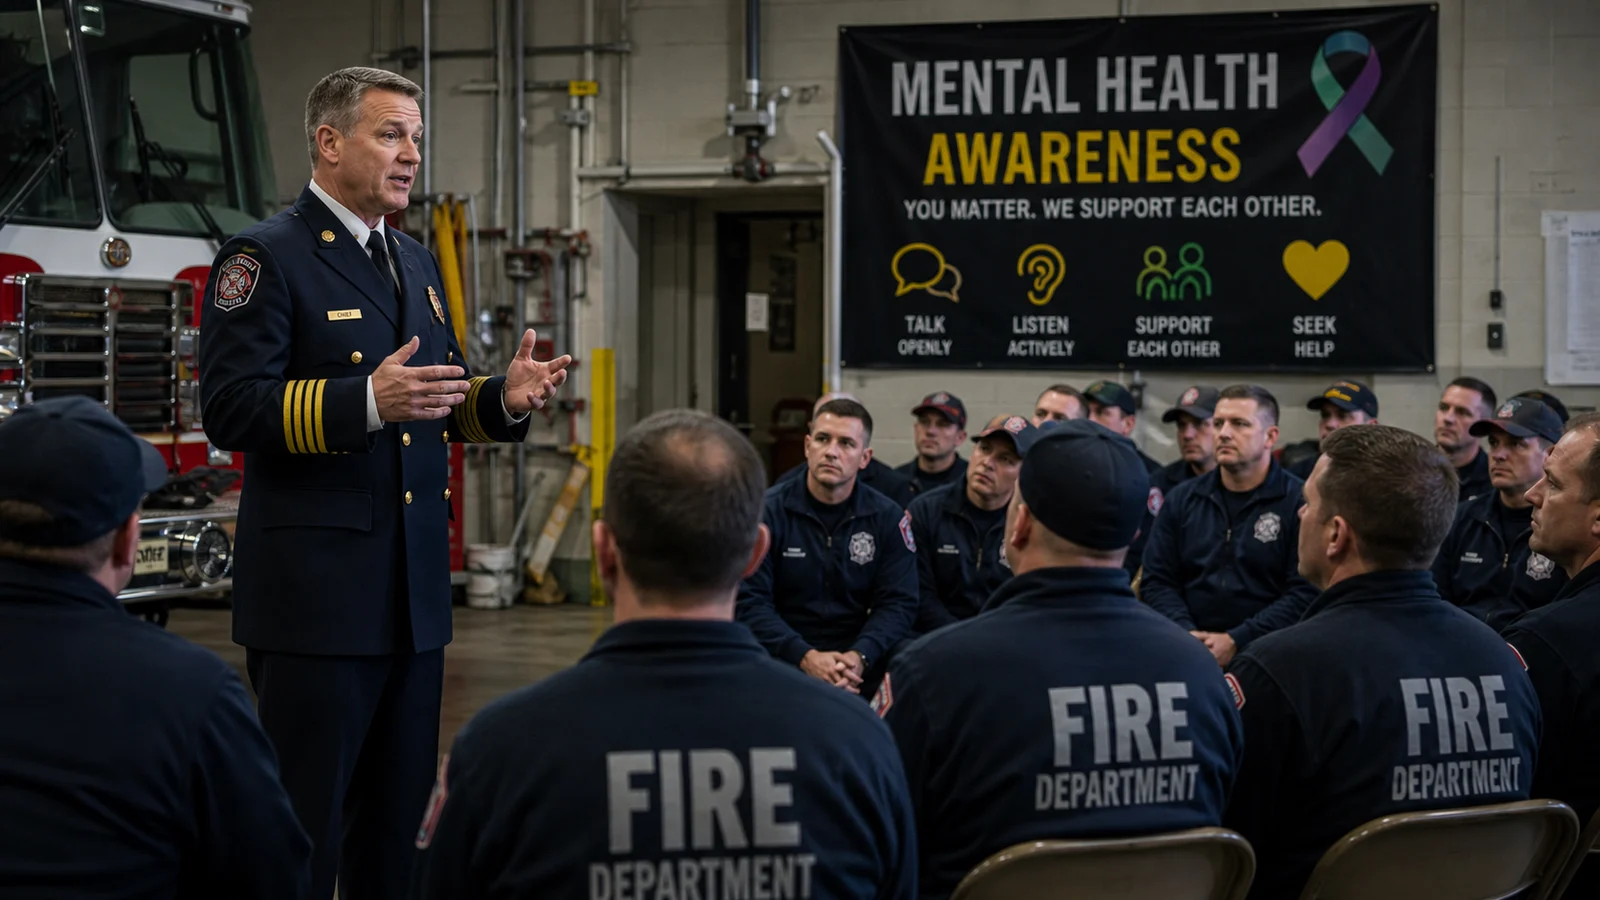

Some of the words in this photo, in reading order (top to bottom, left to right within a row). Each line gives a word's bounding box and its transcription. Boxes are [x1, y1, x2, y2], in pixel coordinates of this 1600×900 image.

[892, 58, 1080, 116] MENTAL
[1097, 52, 1278, 112] HEALTH
[923, 127, 1241, 185] AWARENESS
[903, 199, 945, 220] YOU
[950, 199, 1037, 220] MATTER.
[1043, 198, 1074, 219] WE
[1079, 197, 1176, 219] SUPPORT
[1181, 196, 1238, 218] EACH
[1244, 195, 1322, 218] OTHER.
[904, 315, 946, 334] TALK
[1012, 315, 1069, 335] LISTEN
[1135, 315, 1213, 335] SUPPORT
[1292, 315, 1337, 335] SEEK
[897, 338, 952, 356] OPENLY
[1007, 339, 1075, 357] ACTIVELY
[1127, 340, 1168, 357] EACH
[1170, 340, 1221, 358] OTHER
[1294, 340, 1335, 358] HELP
[1047, 681, 1194, 767] FIRE
[1400, 674, 1515, 756] FIRE
[1035, 764, 1200, 810] DEPARTMENT
[1391, 757, 1521, 801] DEPARTMENT
[606, 747, 802, 854] FIRE
[589, 855, 816, 900] DEPARTMENT
